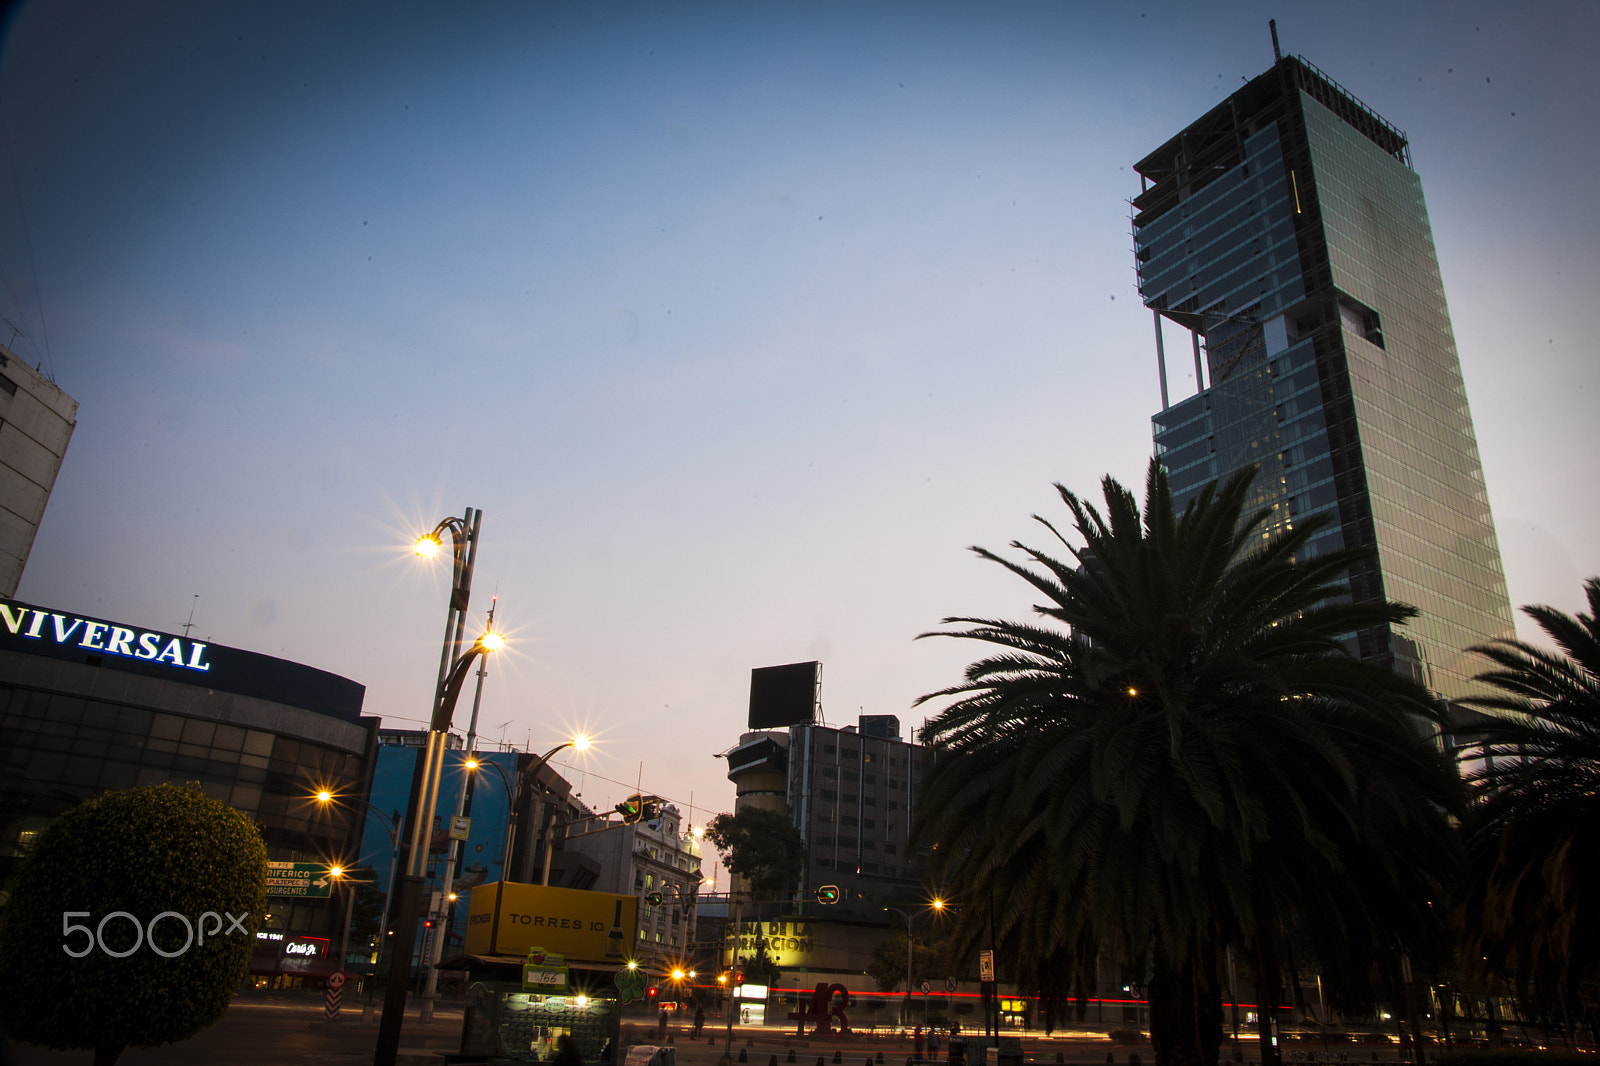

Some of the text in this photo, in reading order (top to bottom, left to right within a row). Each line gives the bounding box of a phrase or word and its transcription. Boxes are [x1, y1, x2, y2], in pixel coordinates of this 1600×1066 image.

[510, 913, 605, 932] TORRES 10
[769, 922, 787, 936] DE
